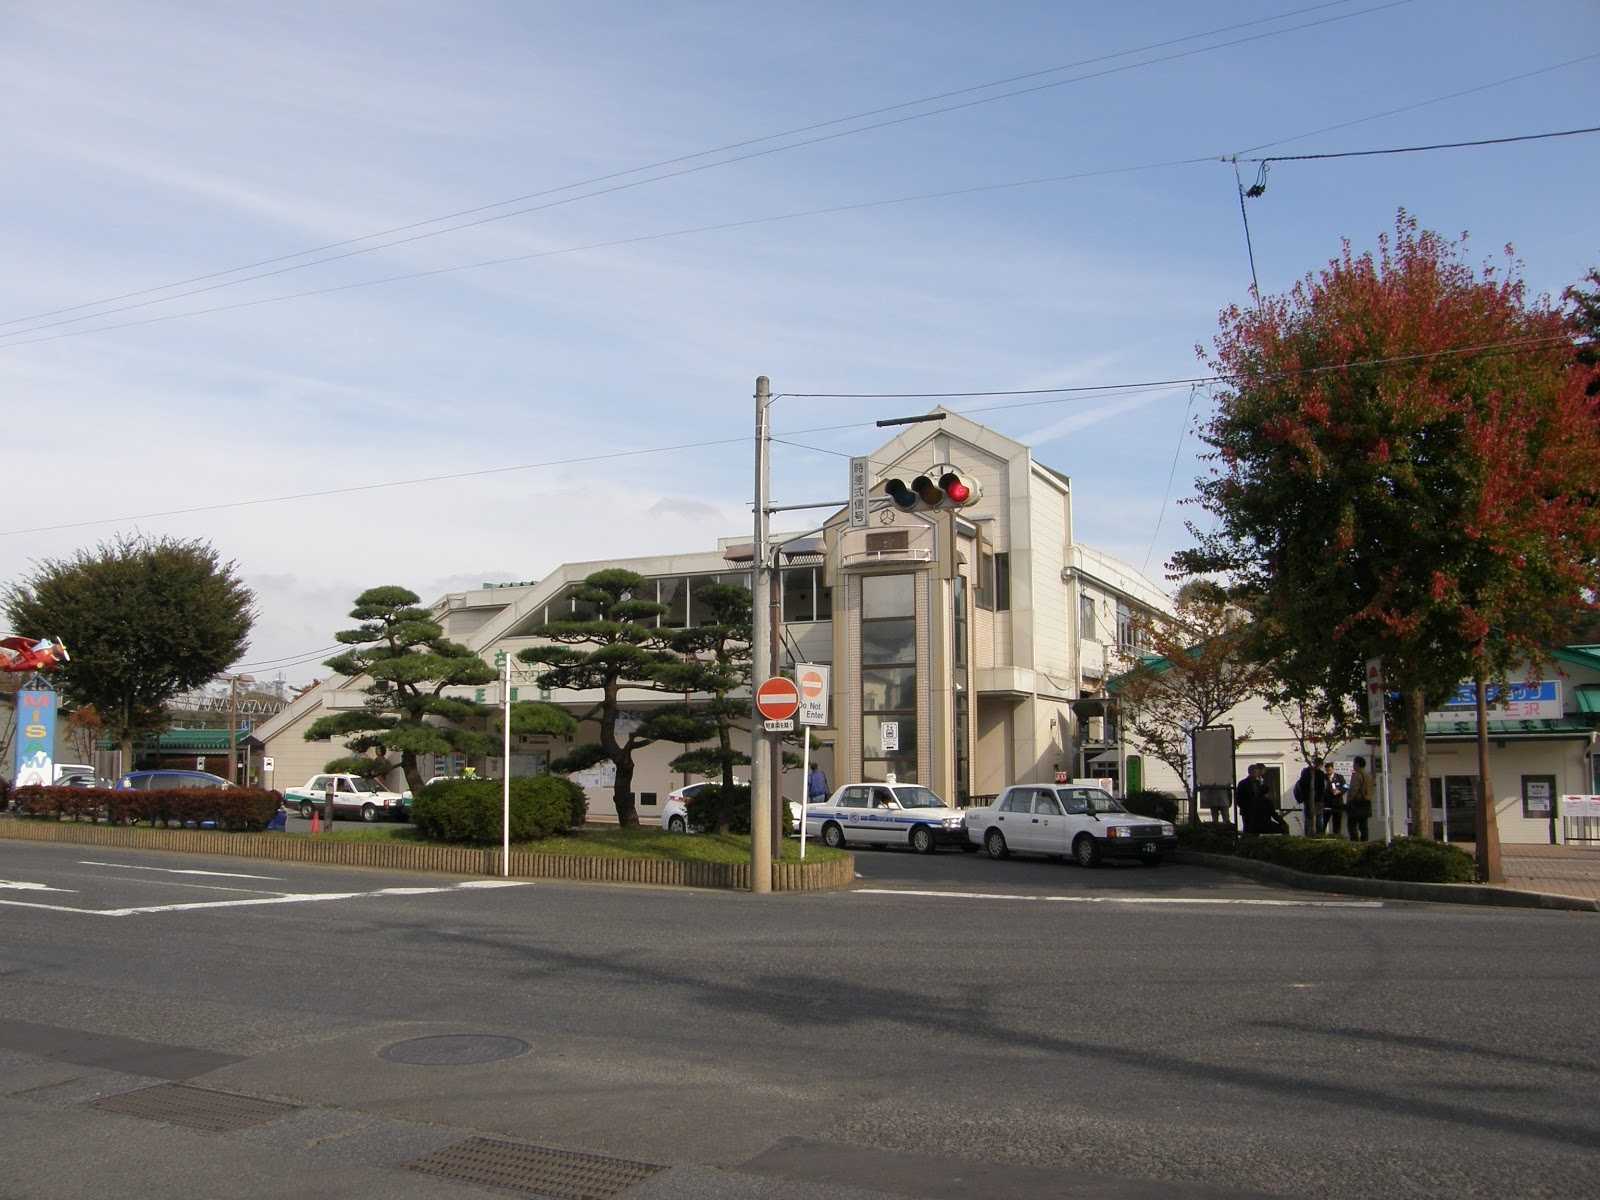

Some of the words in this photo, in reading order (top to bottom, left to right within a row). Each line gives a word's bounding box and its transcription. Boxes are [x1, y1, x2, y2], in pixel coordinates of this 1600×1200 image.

[853, 463, 864, 521] 時差式信号
[799, 701, 807, 709] Do
[810, 702, 821, 710] Not
[806, 710, 824, 719] Enter
